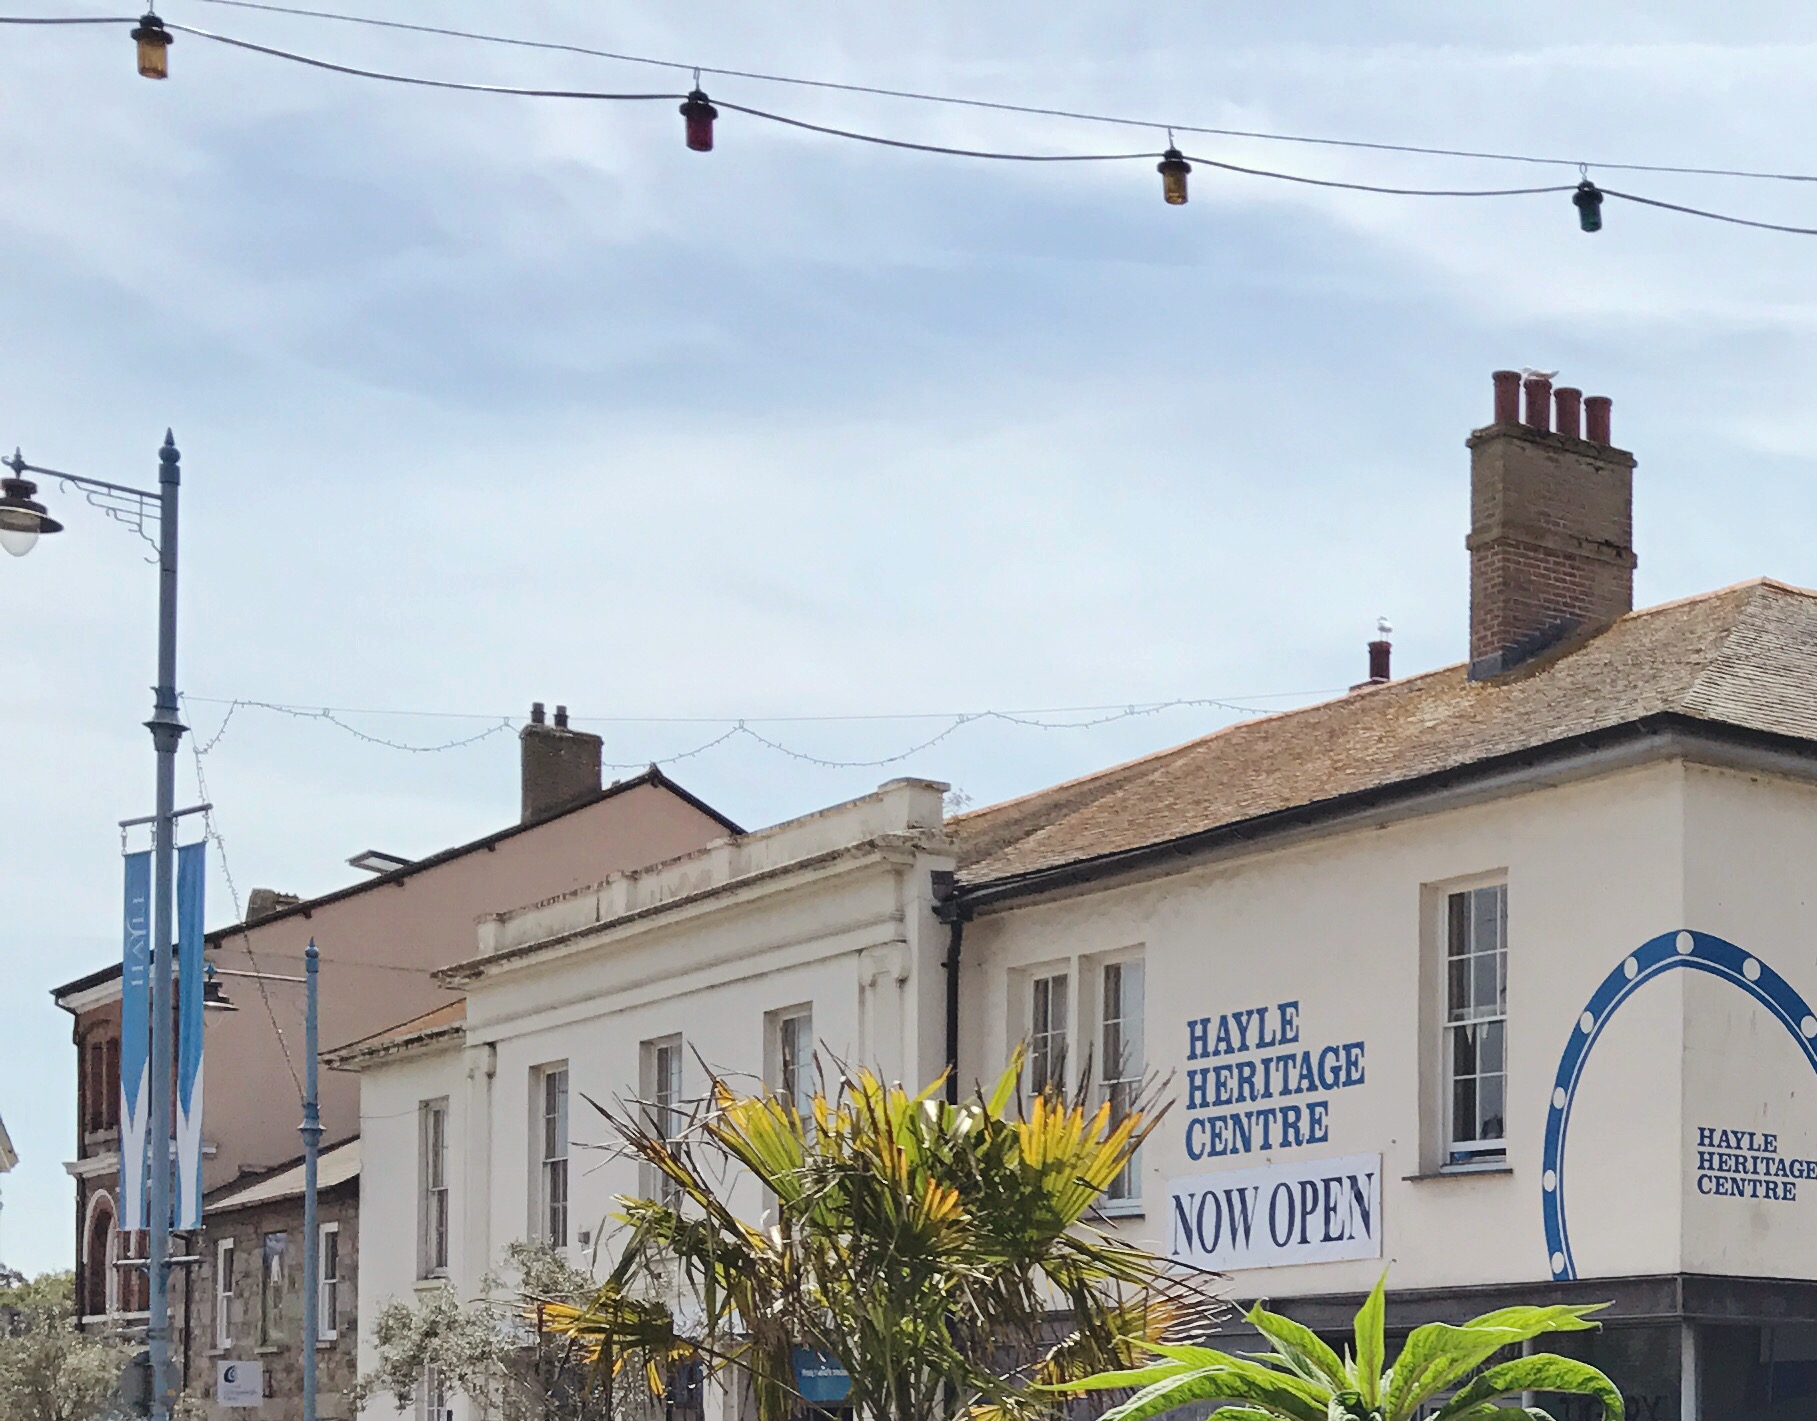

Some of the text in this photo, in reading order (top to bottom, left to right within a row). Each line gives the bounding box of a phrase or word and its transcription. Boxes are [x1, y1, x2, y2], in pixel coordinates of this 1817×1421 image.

[1186, 1000, 1300, 1061] HAYLE
[1185, 1041, 1366, 1110] HERITAGE
[1185, 1100, 1329, 1162] CENTRE
[1697, 1126, 1778, 1153] HAYLE
[1172, 1172, 1375, 1256] NOW OPEN
[1697, 1173, 1797, 1202] CENTRE
